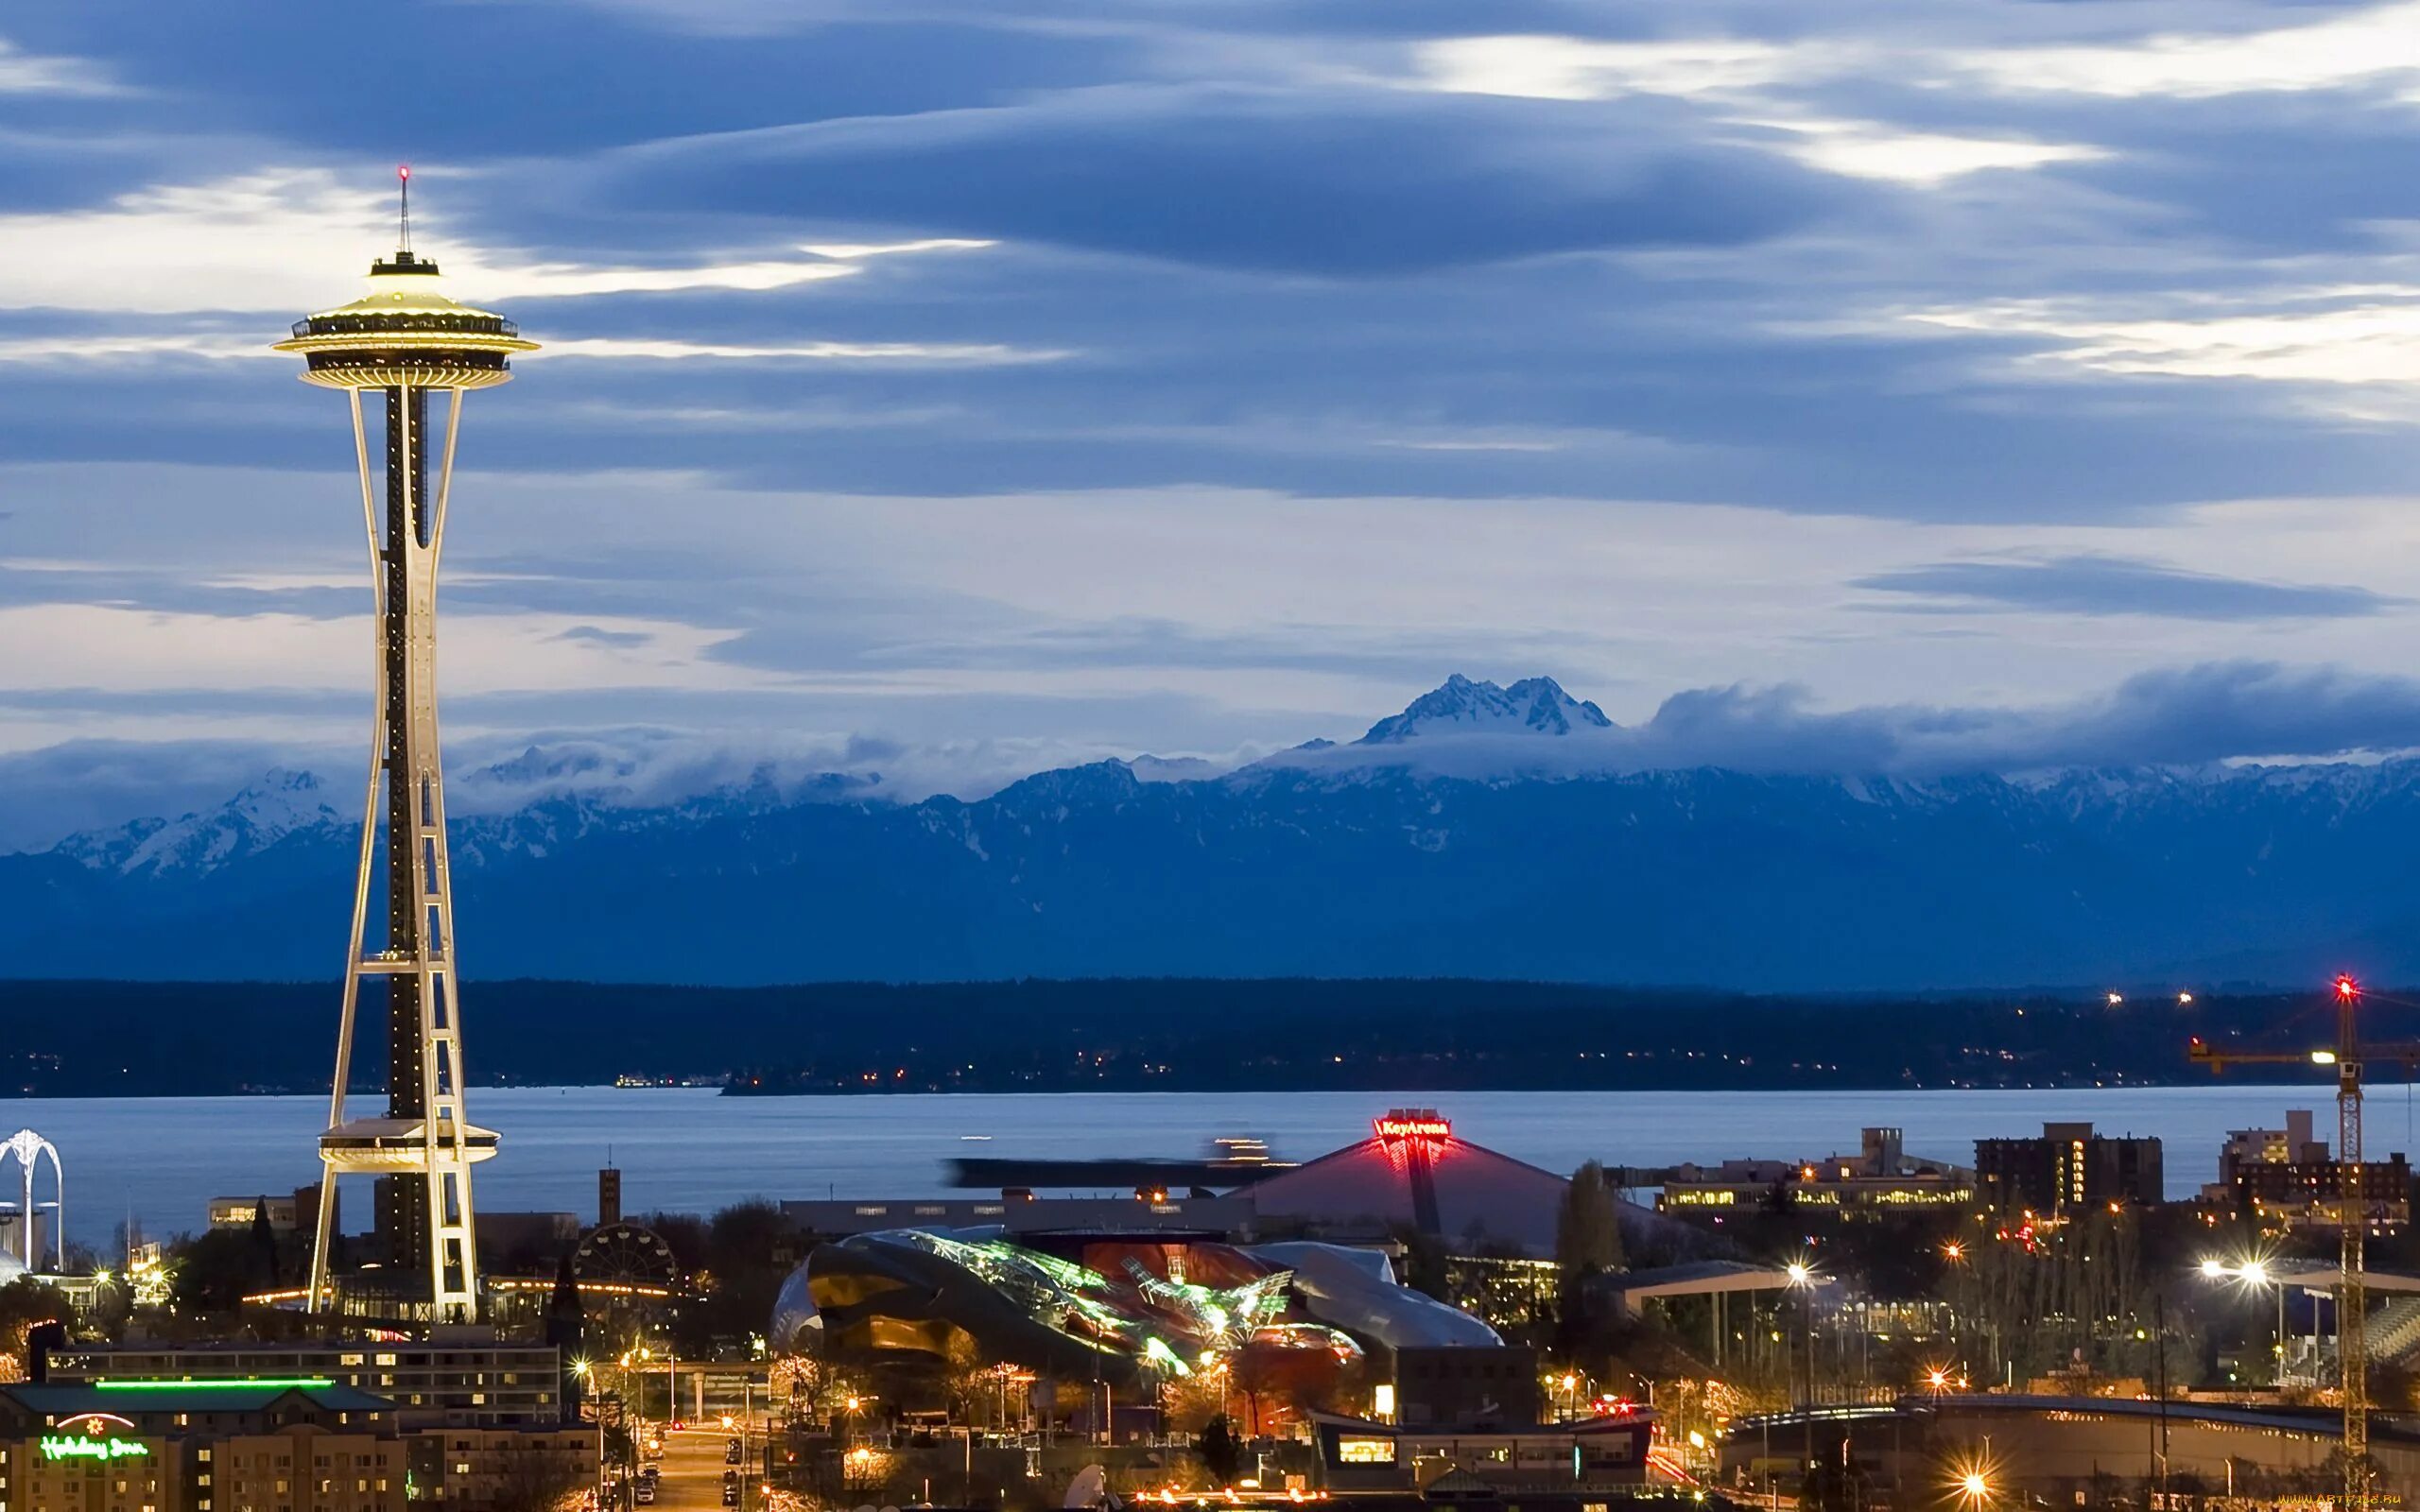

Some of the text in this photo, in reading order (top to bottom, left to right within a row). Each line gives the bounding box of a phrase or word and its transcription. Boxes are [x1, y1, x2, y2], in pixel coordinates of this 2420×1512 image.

[1382, 1121, 1448, 1137] KeyArena
[41, 1436, 148, 1460] Holiday Inn
